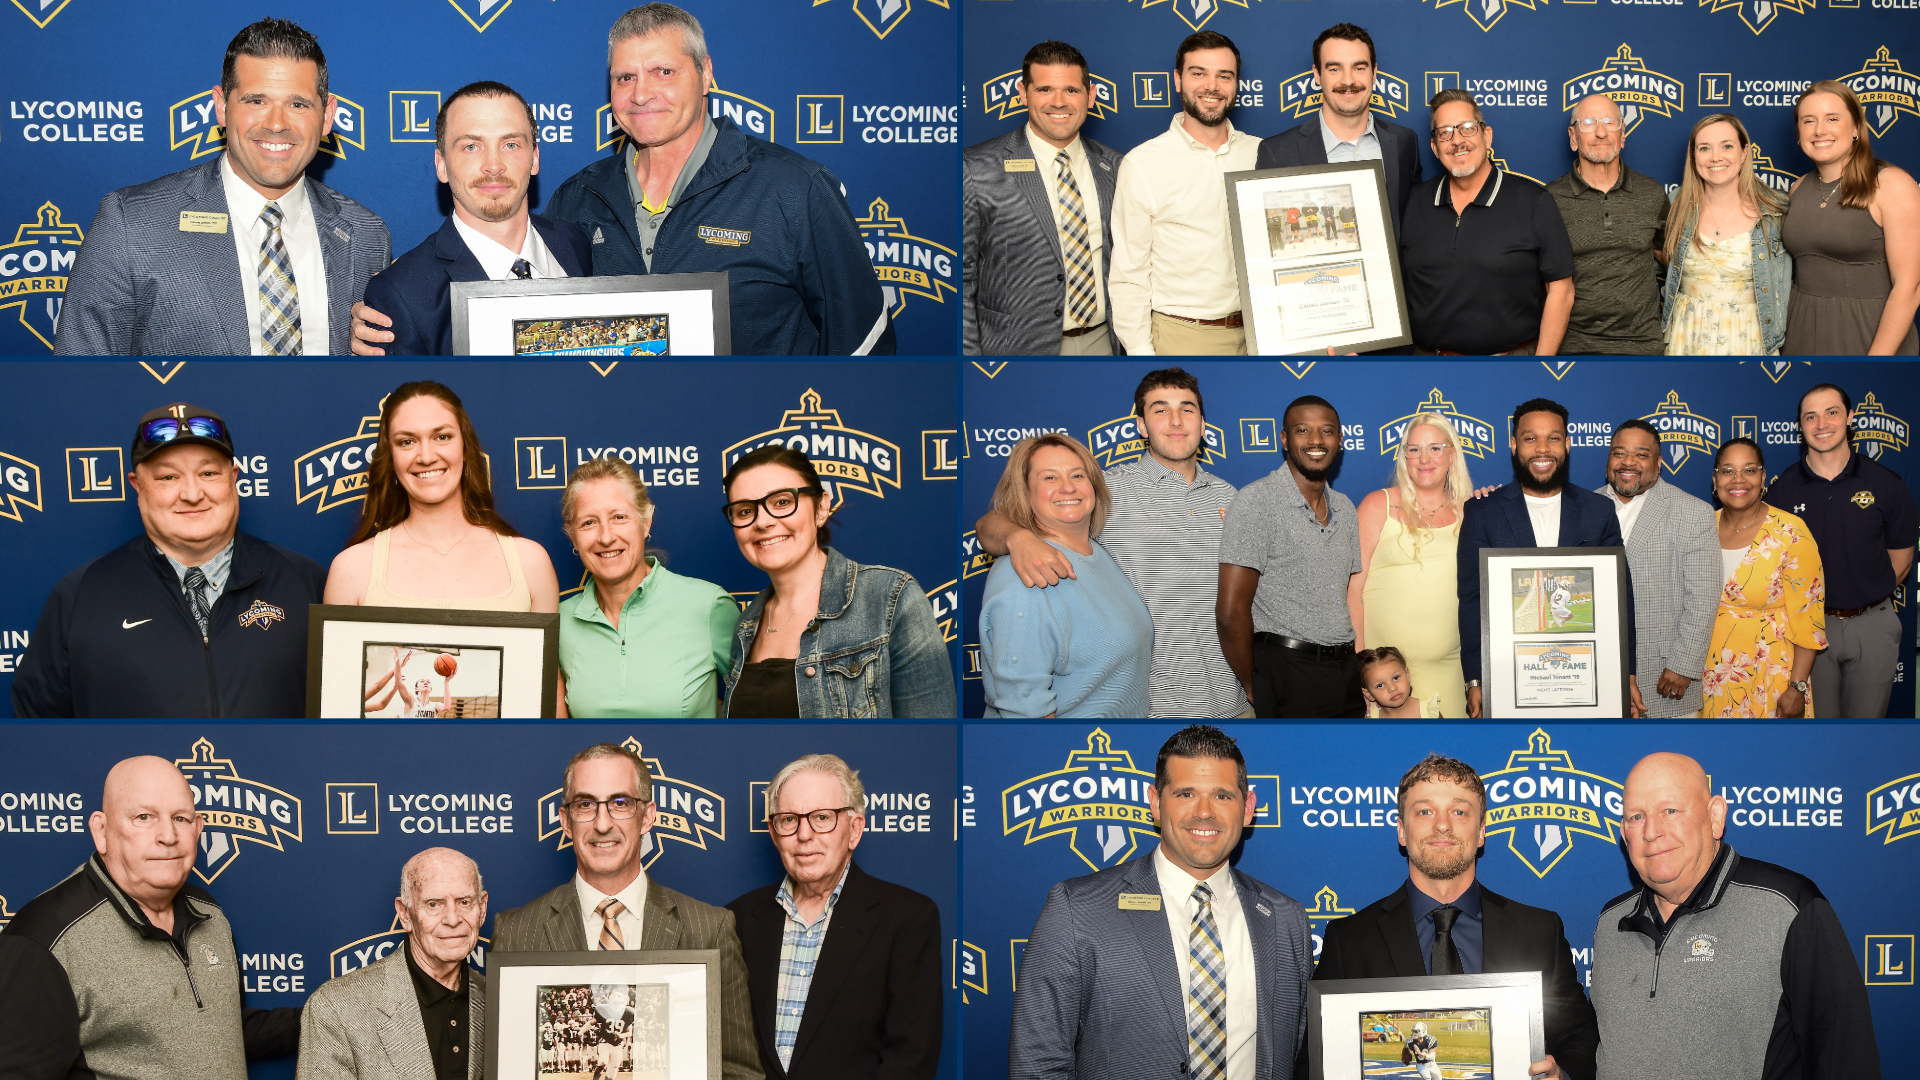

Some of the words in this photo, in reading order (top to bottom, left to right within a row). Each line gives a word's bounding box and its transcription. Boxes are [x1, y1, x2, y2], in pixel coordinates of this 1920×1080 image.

[1465, 79, 1548, 92] LYCOMING
[1569, 73, 1678, 101] LYCOMING
[1736, 80, 1812, 92] LYCOMING
[1474, 94, 1548, 107] COLLEGE
[1742, 94, 1799, 107] COLLE
[1858, 93, 1910, 105] ARRIORS
[10, 100, 143, 120] LYCOMING
[23, 123, 144, 142] COLLEGE
[700, 227, 749, 241] LYCOMING
[1331, 283, 1358, 295] FAME
[1567, 422, 1612, 434] OMING
[1761, 421, 1800, 432] LYCOM
[1570, 436, 1612, 447] LLEGE
[1766, 434, 1802, 445] COLLE
[1856, 432, 1891, 441] ARRIORS
[640, 467, 700, 487] LEGE
[240, 606, 282, 623] LYCOMING
[1540, 652, 1571, 661] LYCOMING
[1523, 663, 1547, 671] HALL
[1562, 661, 1588, 670] FAME
[0, 792, 84, 811] OMING
[388, 793, 513, 812] LYCOMING
[1290, 786, 1399, 805] LYCOMIN
[1721, 786, 1843, 805] LYCOMING
[1049, 805, 1154, 823] WARRIORS
[1302, 809, 1400, 827] COLLEG
[1490, 805, 1591, 822] WARRIORS
[1732, 809, 1843, 827] COLLEGE
[400, 815, 514, 834] COLLEGE
[243, 975, 305, 993] LEGE
[606, 1019, 625, 1034] 39
